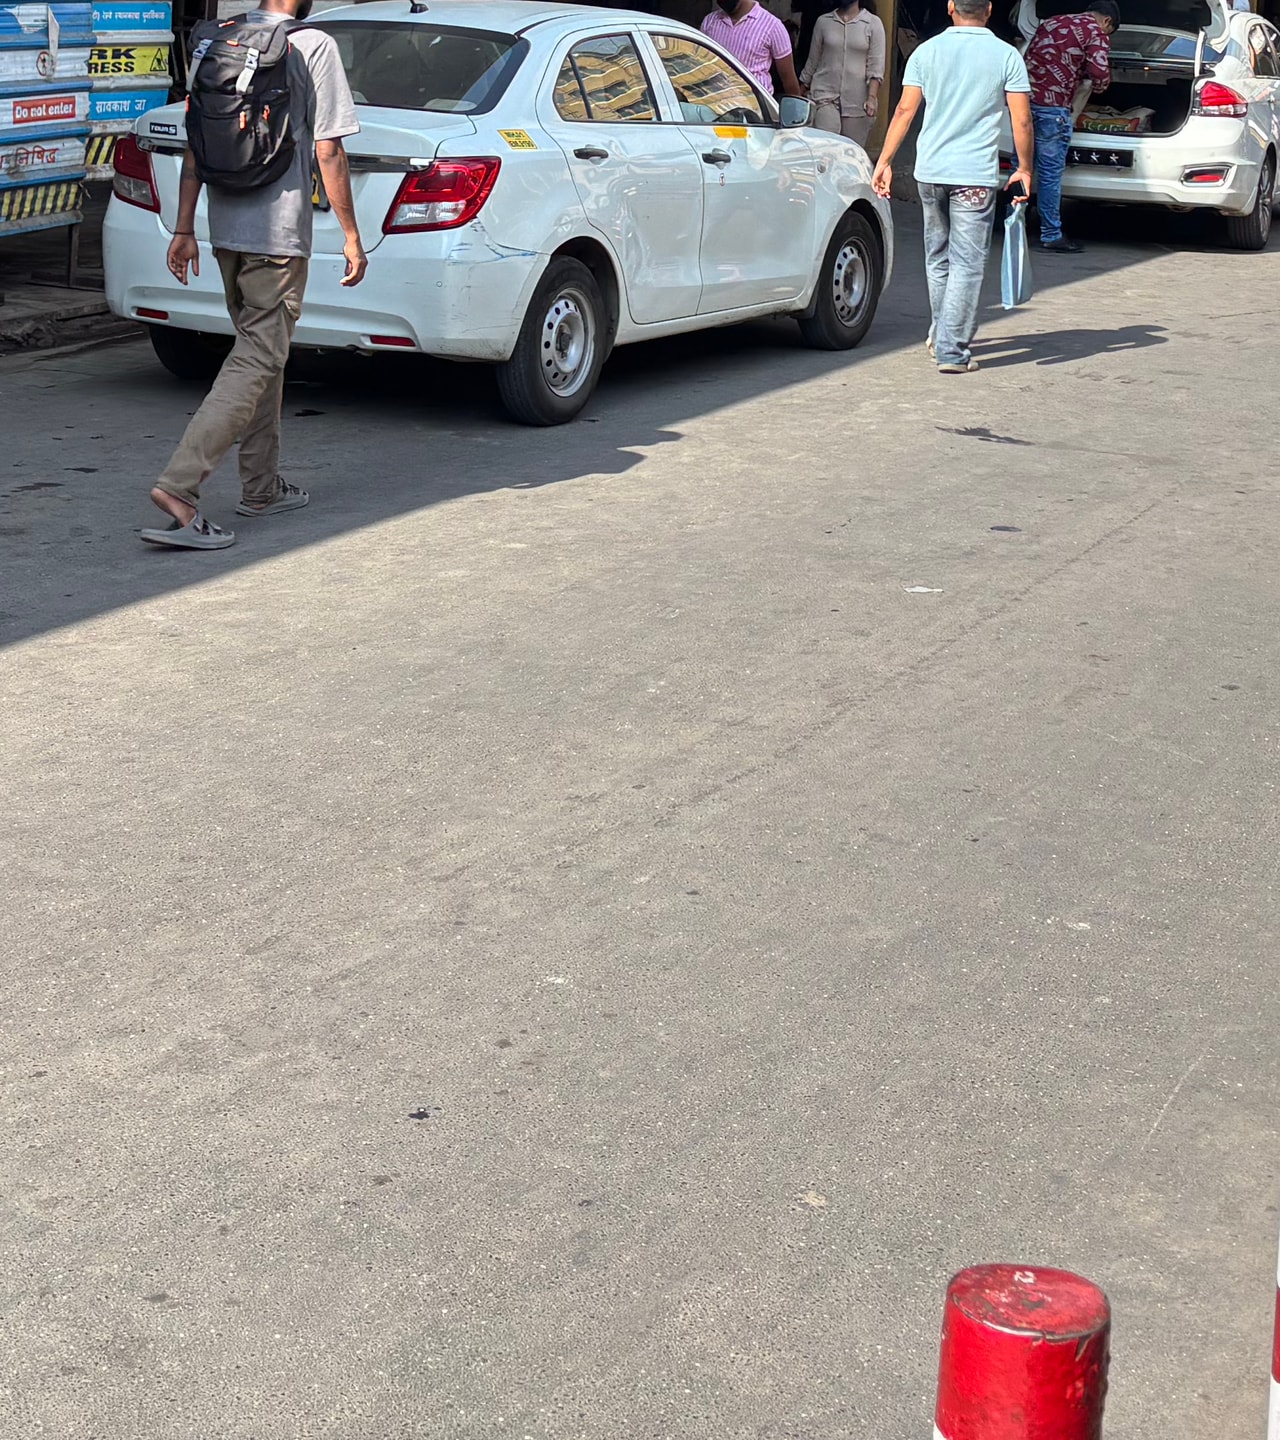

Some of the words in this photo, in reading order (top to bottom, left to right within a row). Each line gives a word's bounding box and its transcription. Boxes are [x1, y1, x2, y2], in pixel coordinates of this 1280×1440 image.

[15, 106, 27, 118] Do
[30, 104, 47, 117] not
[48, 102, 73, 116] enter
